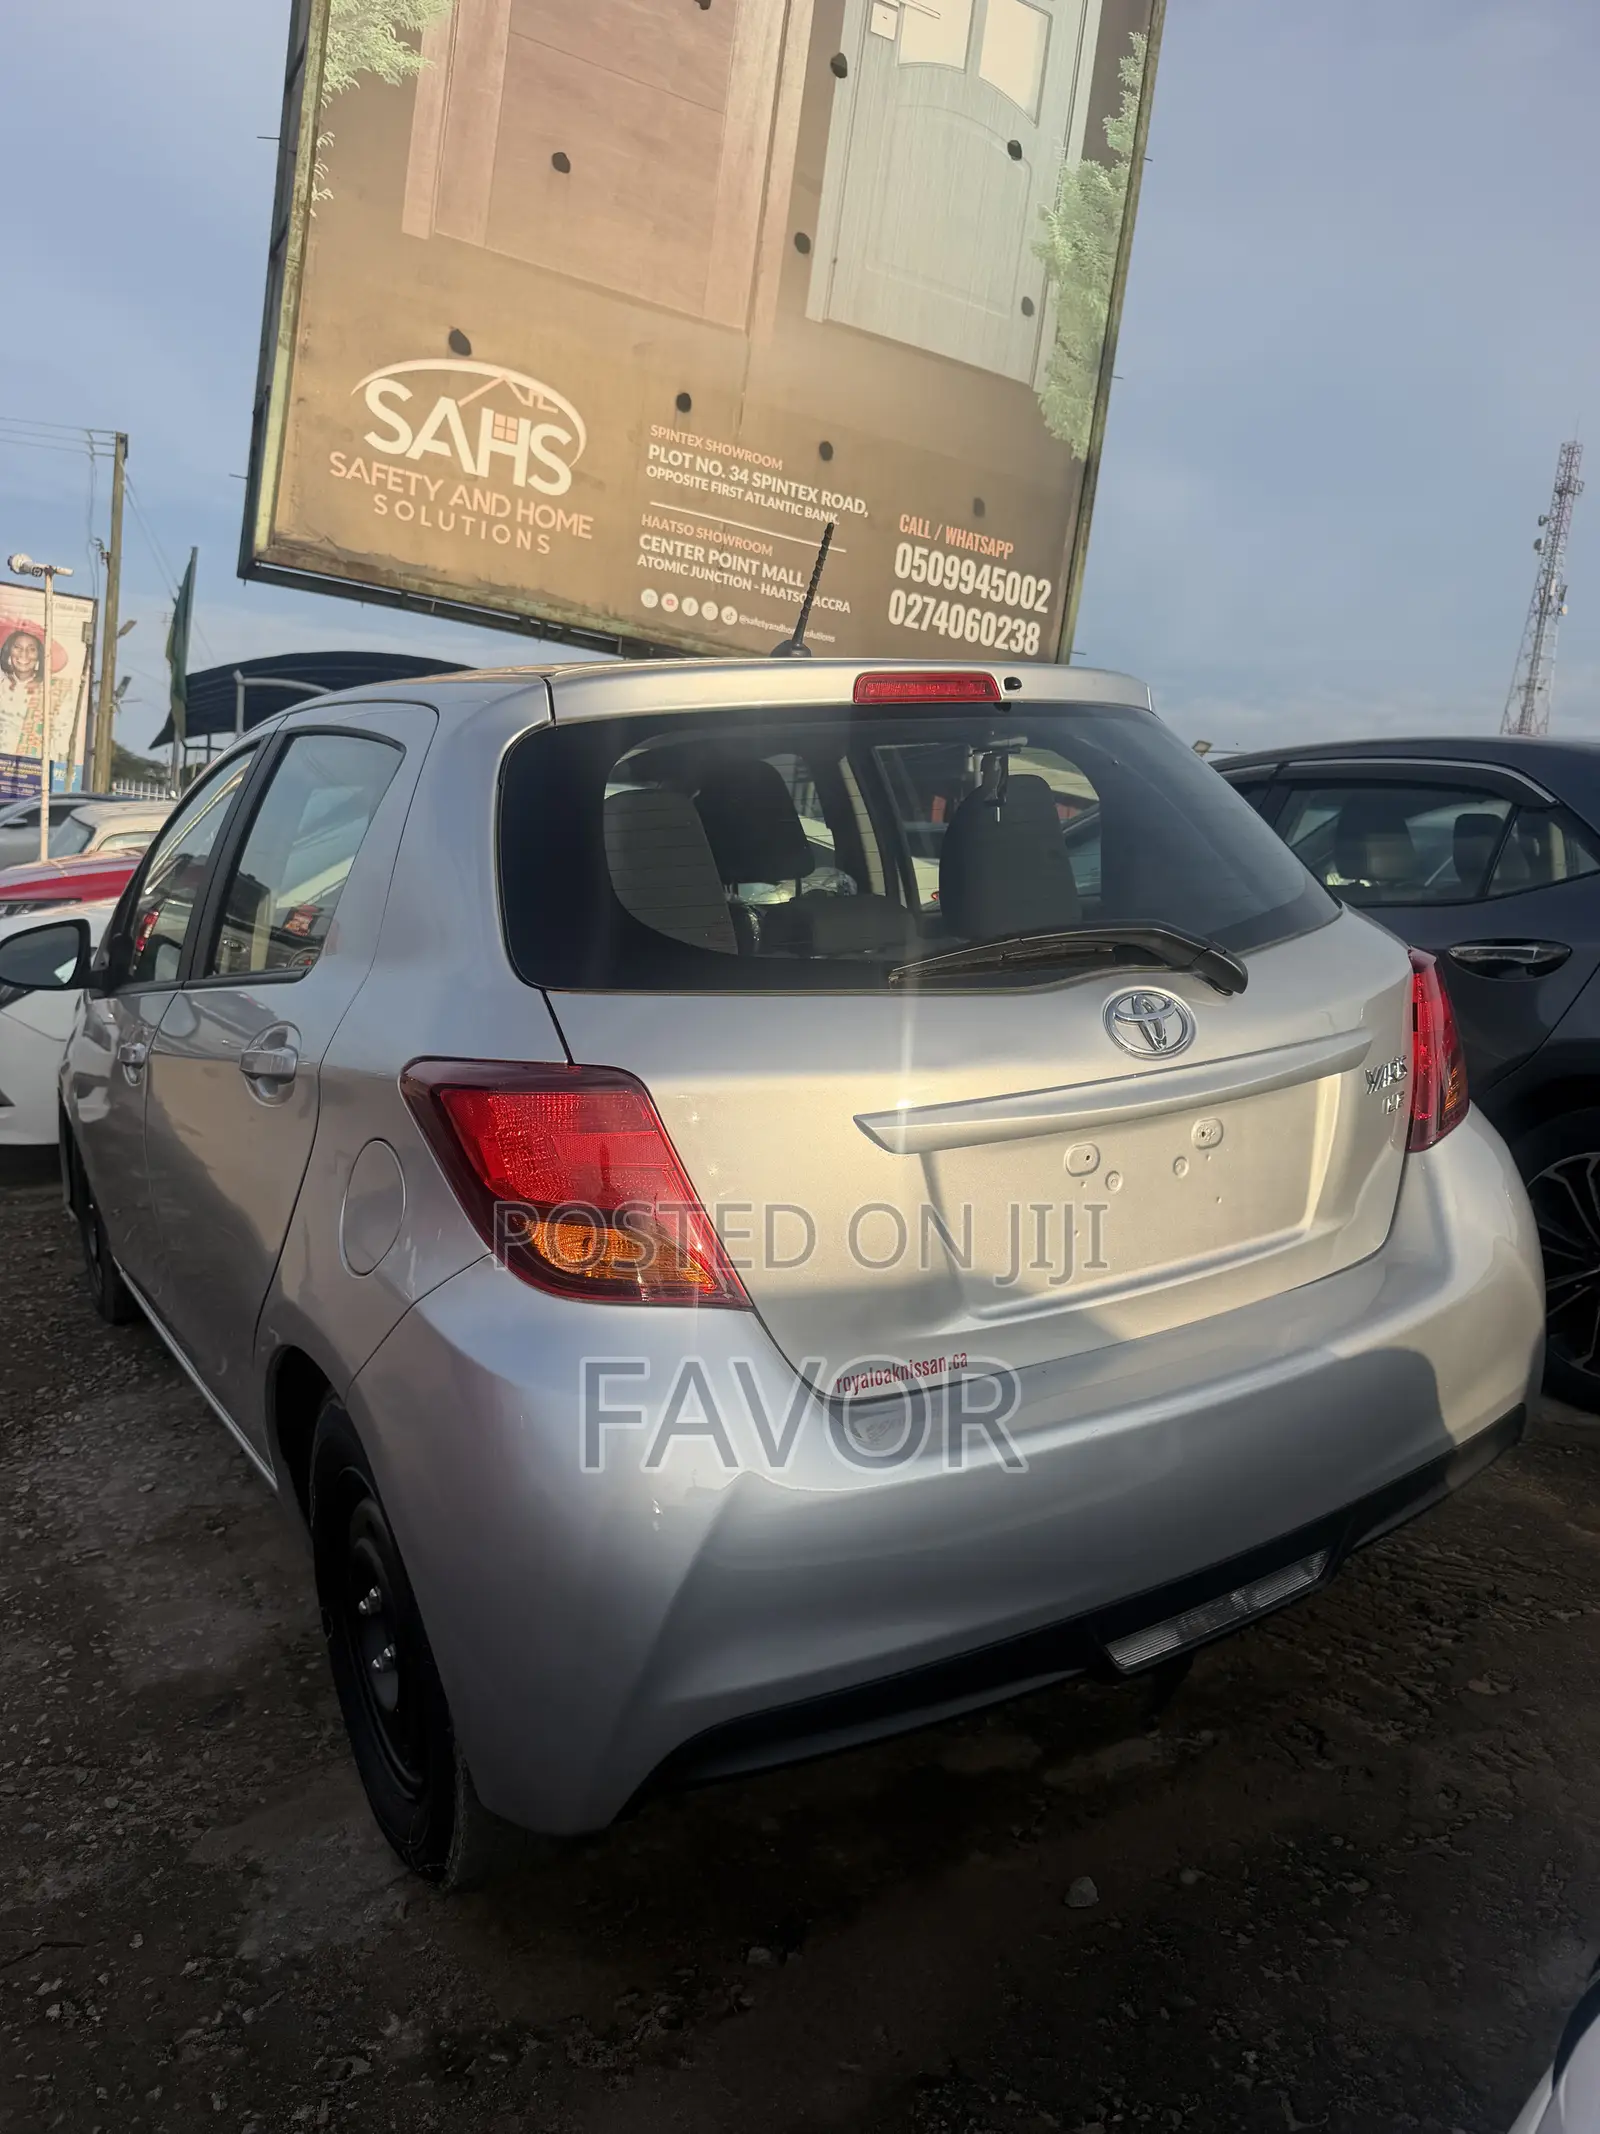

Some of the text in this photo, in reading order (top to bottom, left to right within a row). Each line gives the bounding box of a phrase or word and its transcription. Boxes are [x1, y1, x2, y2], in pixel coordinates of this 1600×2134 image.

[364, 378, 572, 496] SAHS
[650, 425, 783, 471] SPINTEX SHOWROOM
[329, 451, 594, 539] SAFETY AND HOME
[646, 466, 840, 525] OPPOSITE FIRST ATLANTIC BANK.
[648, 444, 869, 518] PLOT NO. 34 SPINTEX ROAD,
[374, 494, 550, 554] SOLUTIONS
[642, 514, 773, 556] HAATSO SHOWROOM
[899, 513, 1014, 560] CALL / WHATSAPP
[637, 554, 689, 576] ATOMIC
[689, 567, 752, 591] JUNCTION
[812, 596, 851, 613] ACCRA
[640, 534, 804, 587] CENTER POINT MALL
[894, 542, 1052, 614] 0509945002
[888, 589, 1041, 656] 0274060238
[836, 1352, 968, 1396] royaloaknissan.ca
